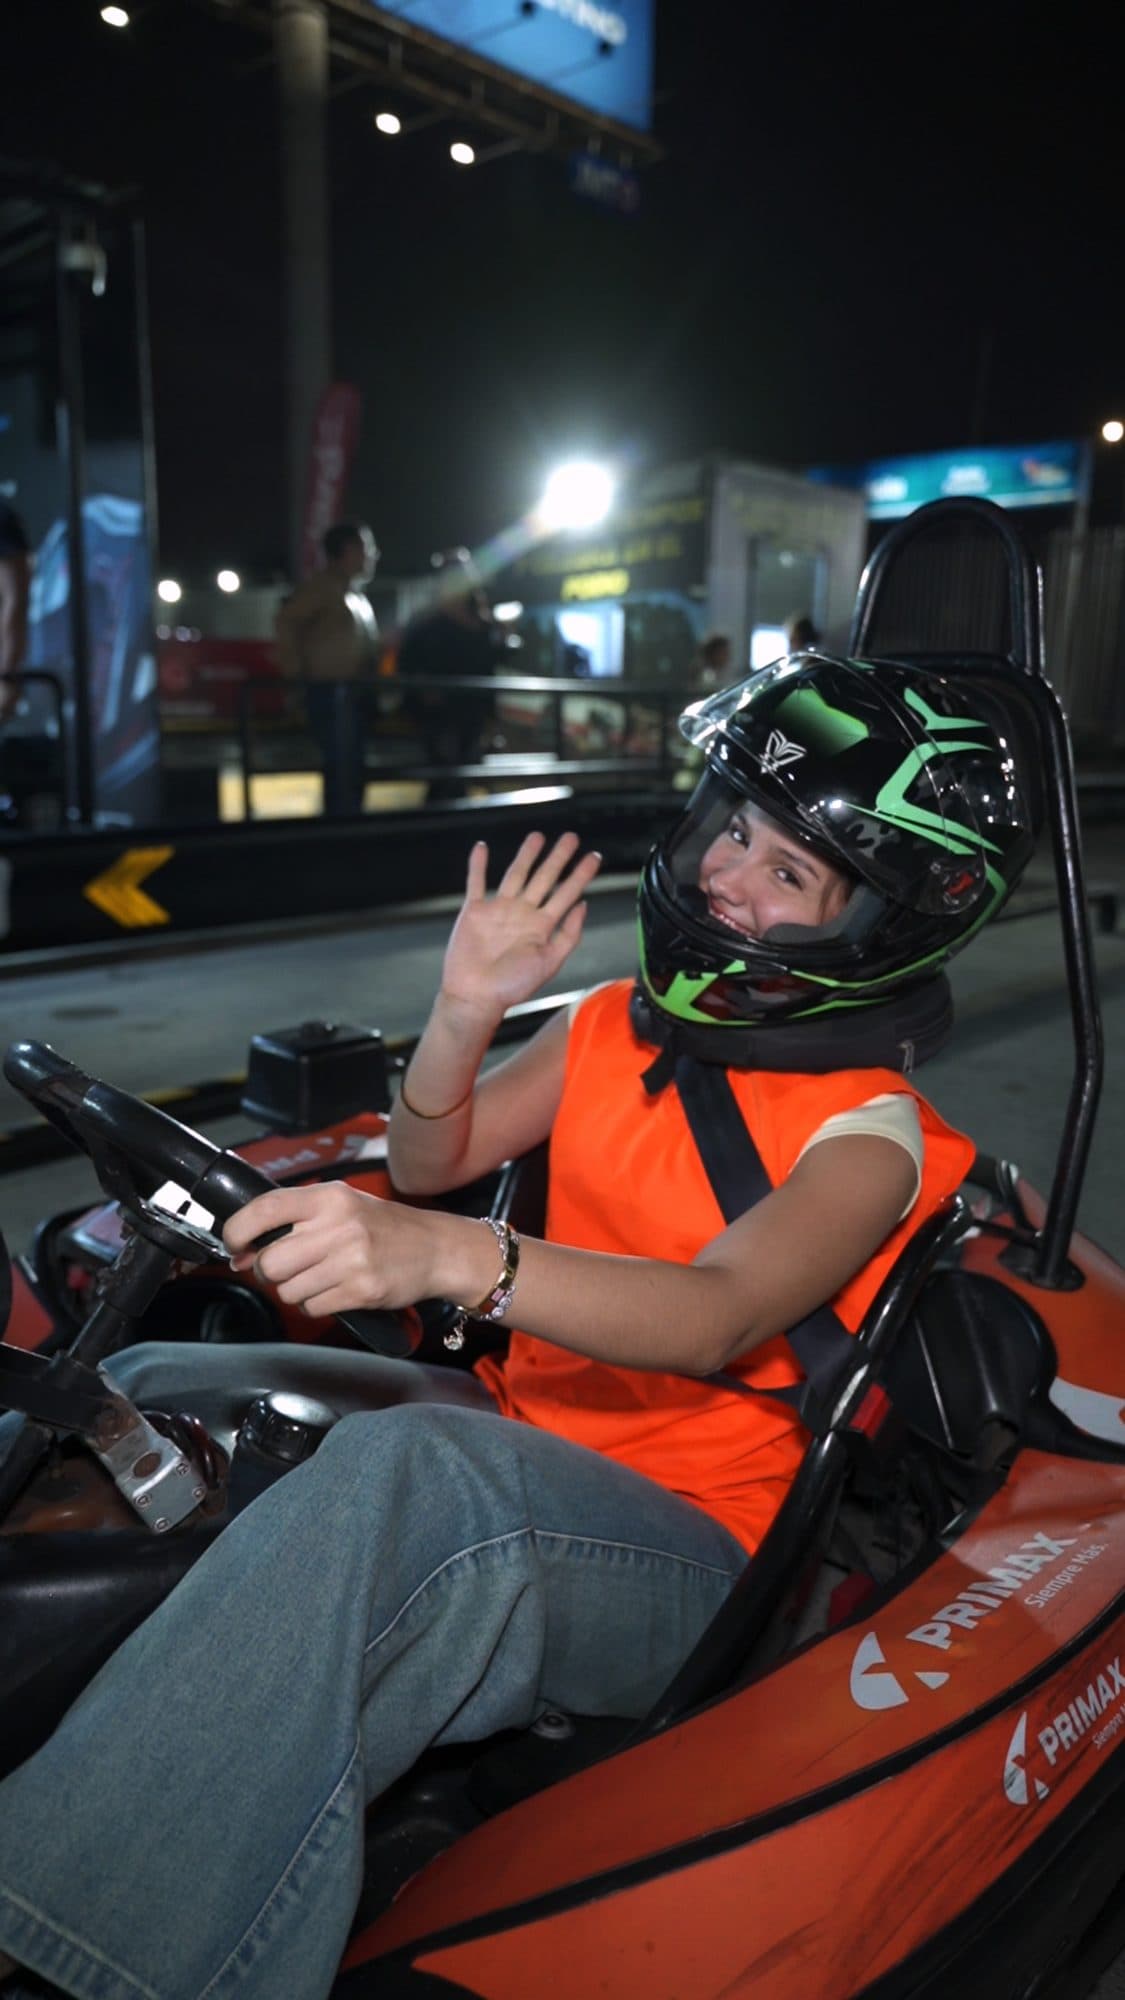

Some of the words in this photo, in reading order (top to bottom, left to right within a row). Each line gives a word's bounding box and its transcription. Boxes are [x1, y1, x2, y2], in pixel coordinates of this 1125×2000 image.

[905, 1531, 1078, 1650] PRIMAX
[1024, 1561, 1083, 1609] Siempre
[1037, 1655, 1125, 1766] PRIMAX
